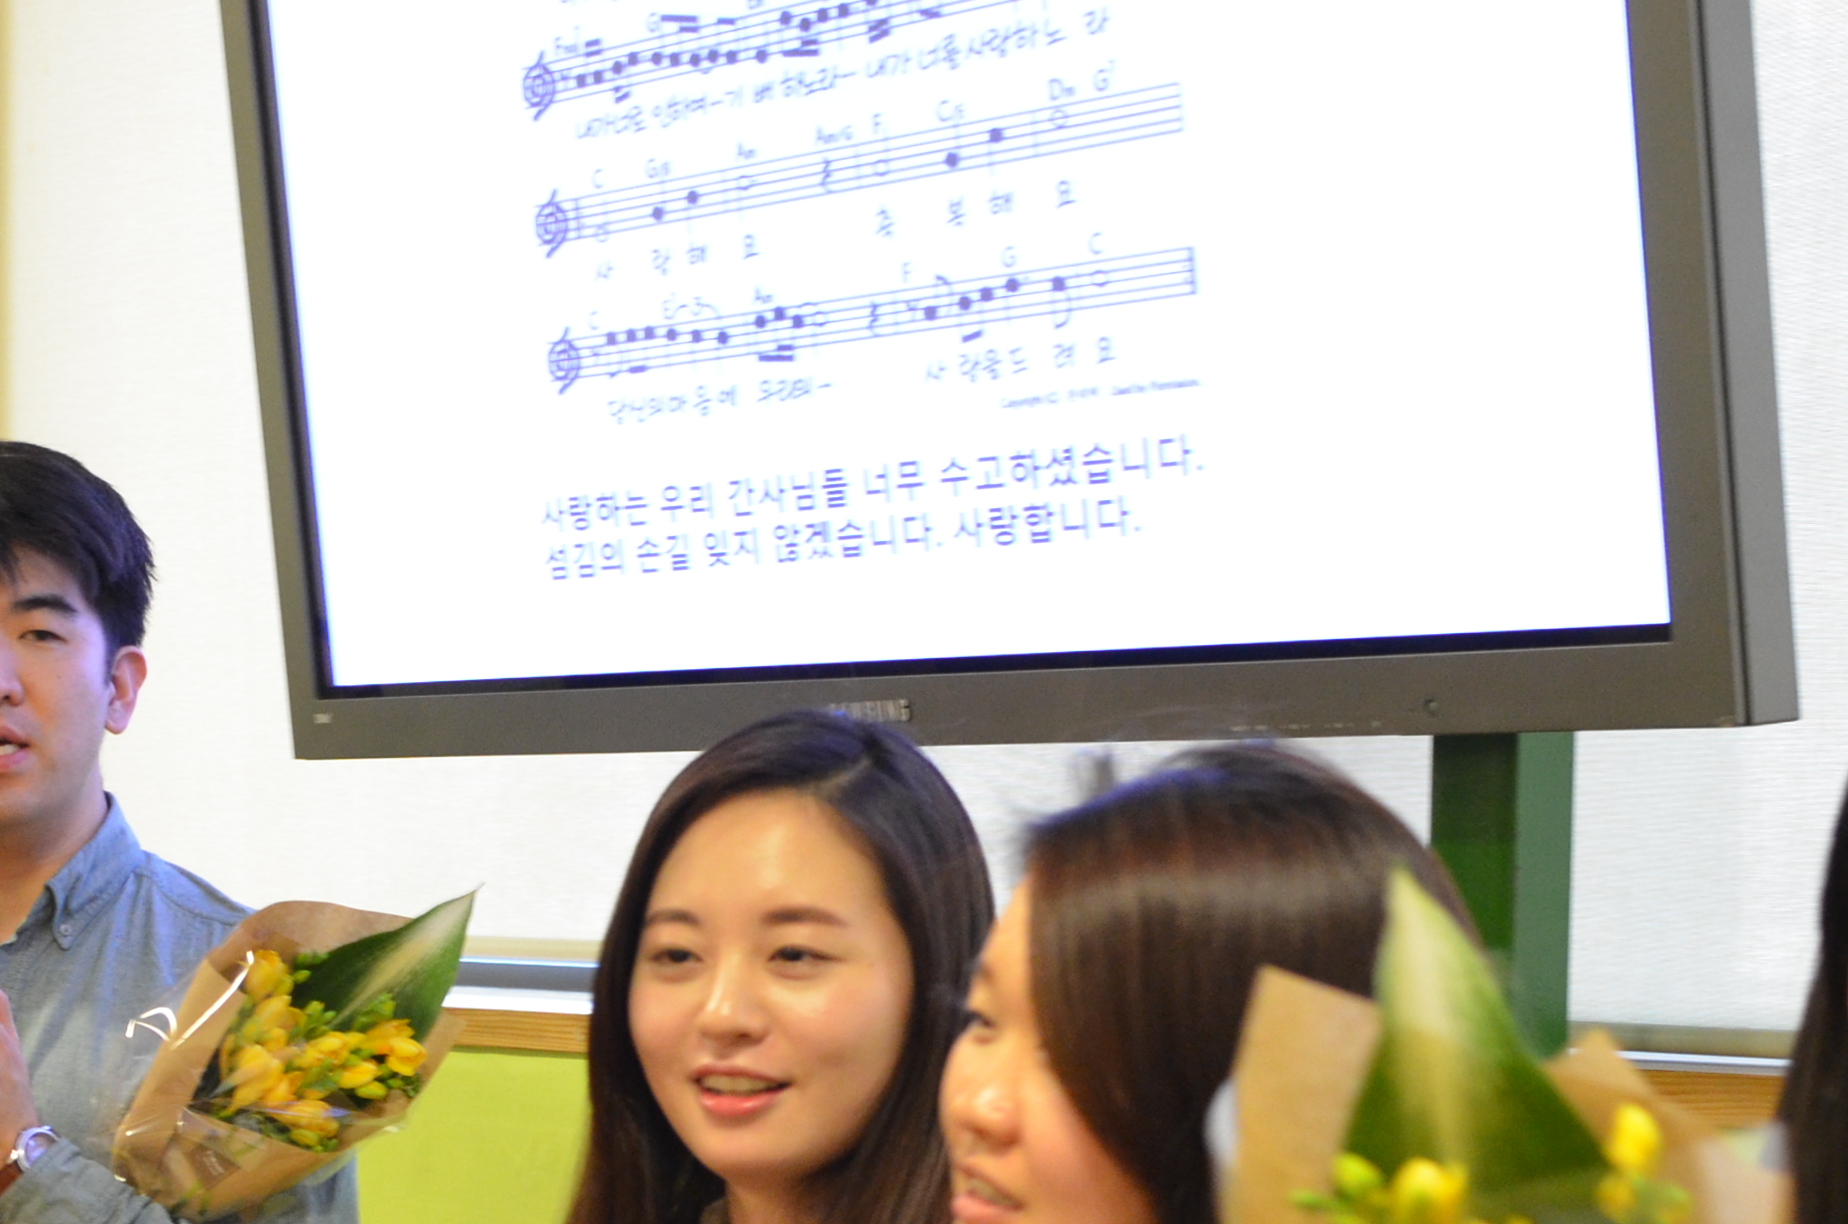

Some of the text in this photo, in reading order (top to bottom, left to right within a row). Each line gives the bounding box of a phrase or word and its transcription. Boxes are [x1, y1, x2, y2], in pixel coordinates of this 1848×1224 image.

[541, 490, 651, 532] 사랑하는
[660, 482, 715, 522] 우리
[864, 460, 927, 503] 너무
[939, 434, 1205, 498] 수고하셨습니다.
[546, 539, 626, 580] 섬김의
[636, 533, 692, 573] 손길
[703, 527, 760, 567] 잊지
[954, 493, 1142, 548] 사랑합니다.
